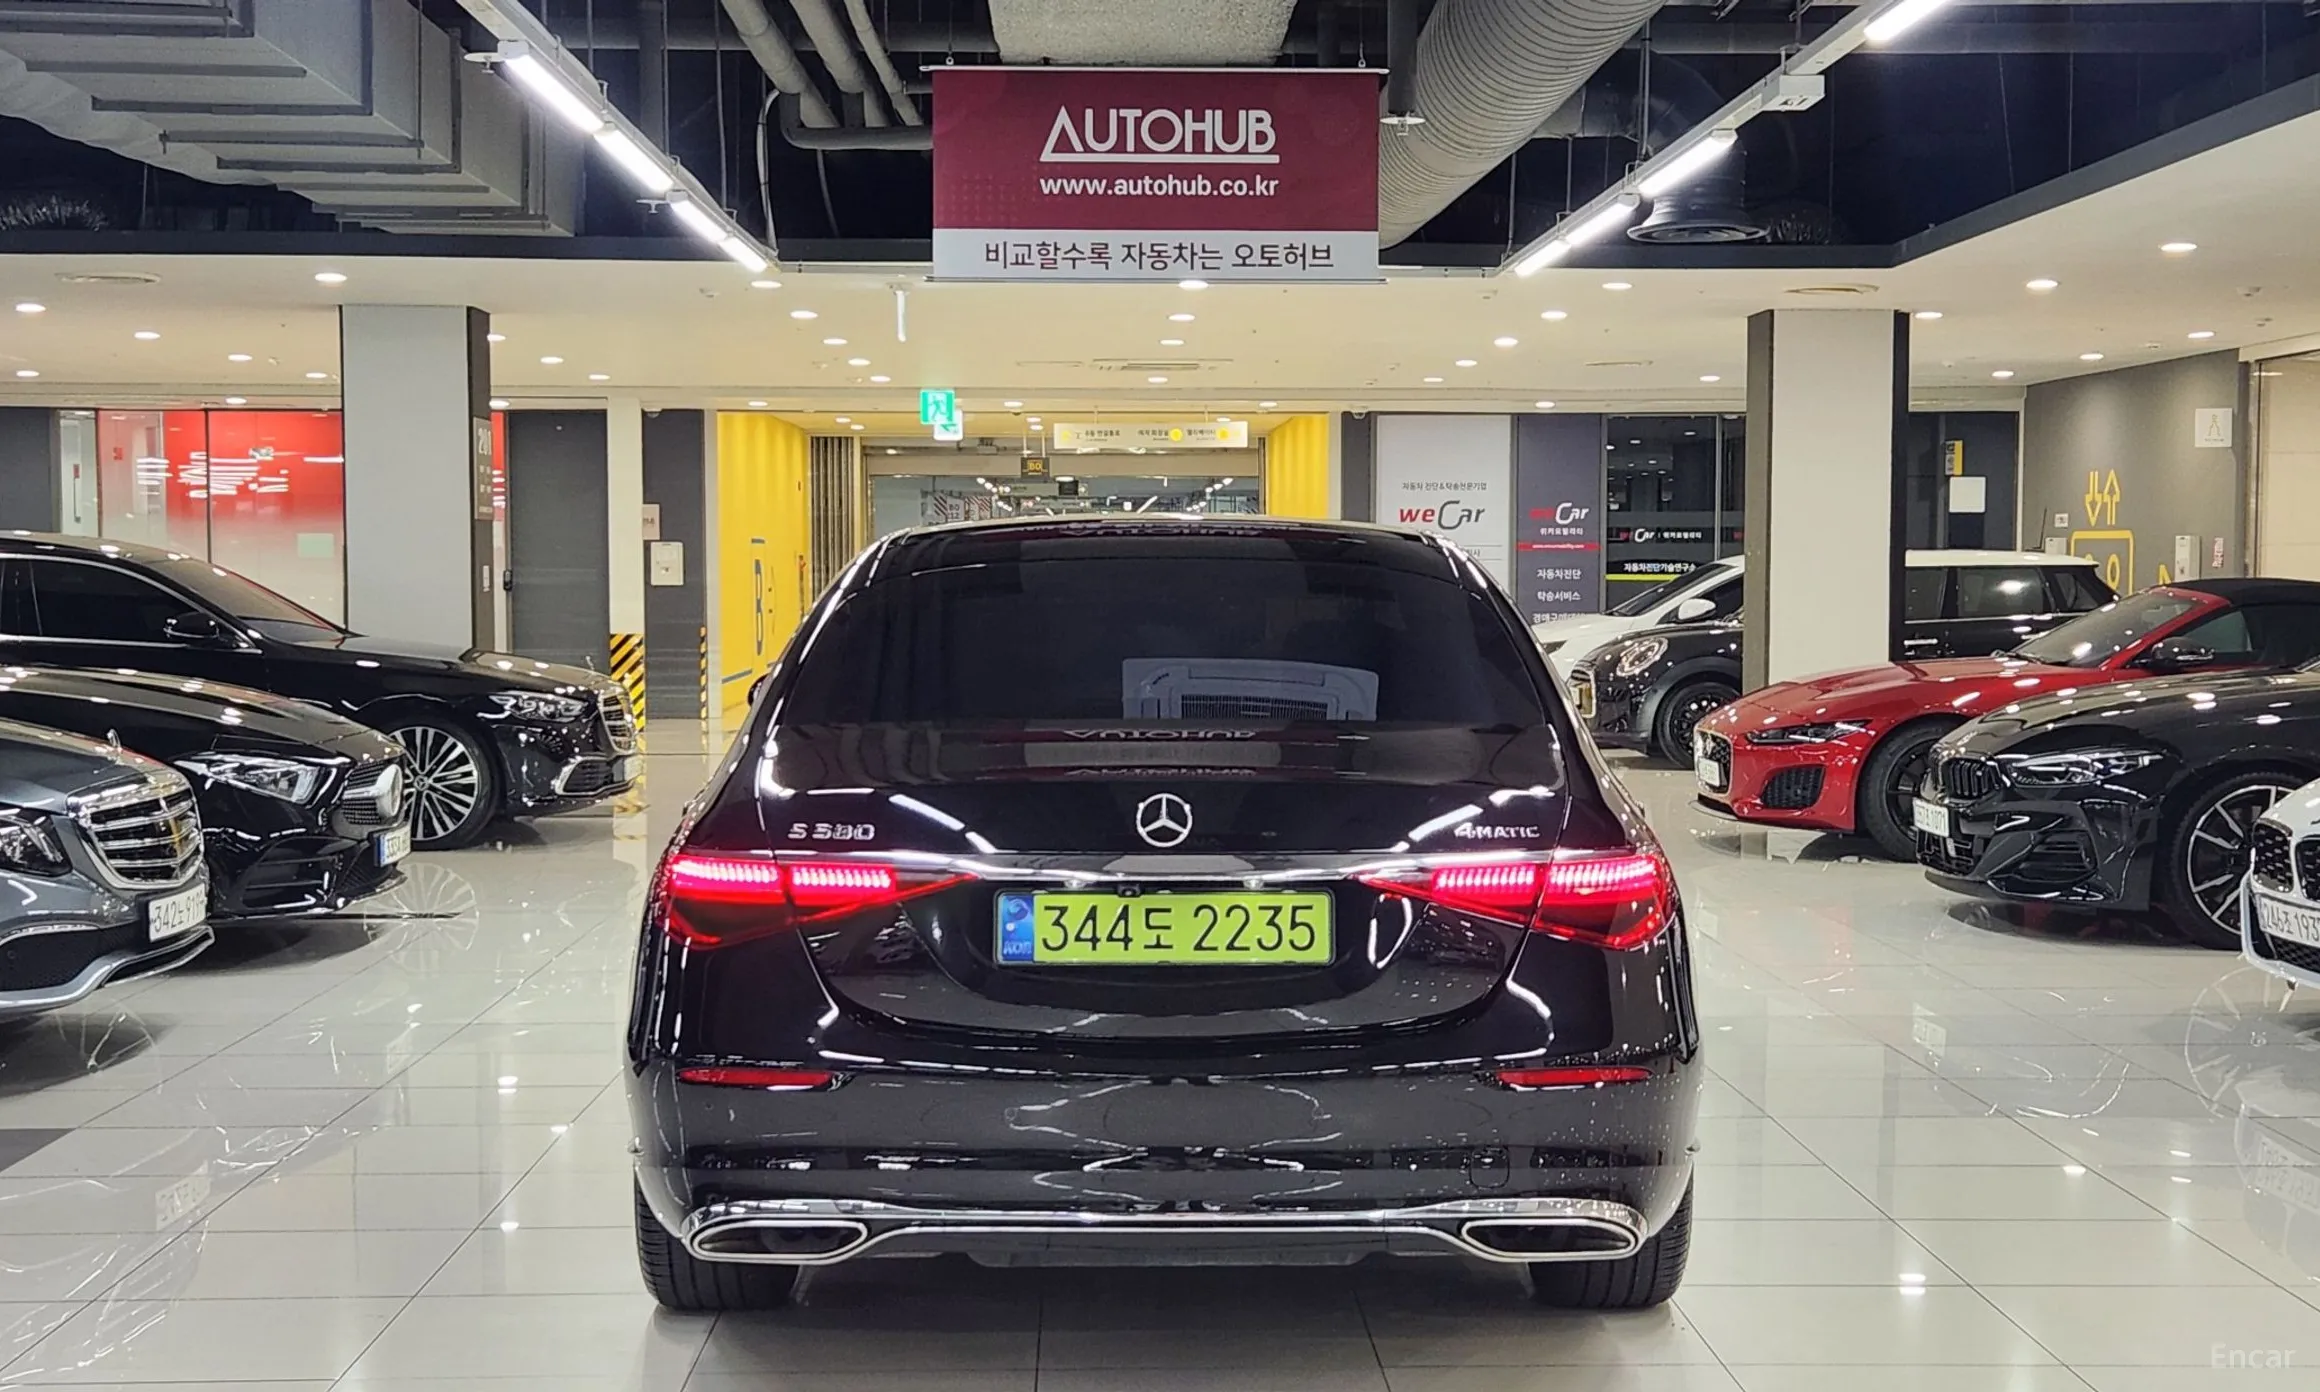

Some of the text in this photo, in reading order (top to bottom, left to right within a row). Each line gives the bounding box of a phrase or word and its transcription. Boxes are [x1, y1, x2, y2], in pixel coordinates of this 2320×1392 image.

[1040, 105, 1280, 164] AUTOHUB
[1040, 174, 1279, 196] www.autohub.co.kr
[985, 241, 1334, 271] 비교할수록 자동차는 오토허브
[1399, 500, 1486, 530] weCar
[1620, 528, 1655, 542] Car
[1537, 568, 1582, 580] 자동차진단
[1537, 590, 1582, 602] 탁송서비스
[787, 822, 809, 840] S
[1453, 821, 1541, 840] 4MATIC
[1041, 904, 1317, 952] 344도 2235
[2294, 911, 2320, 942] 193
